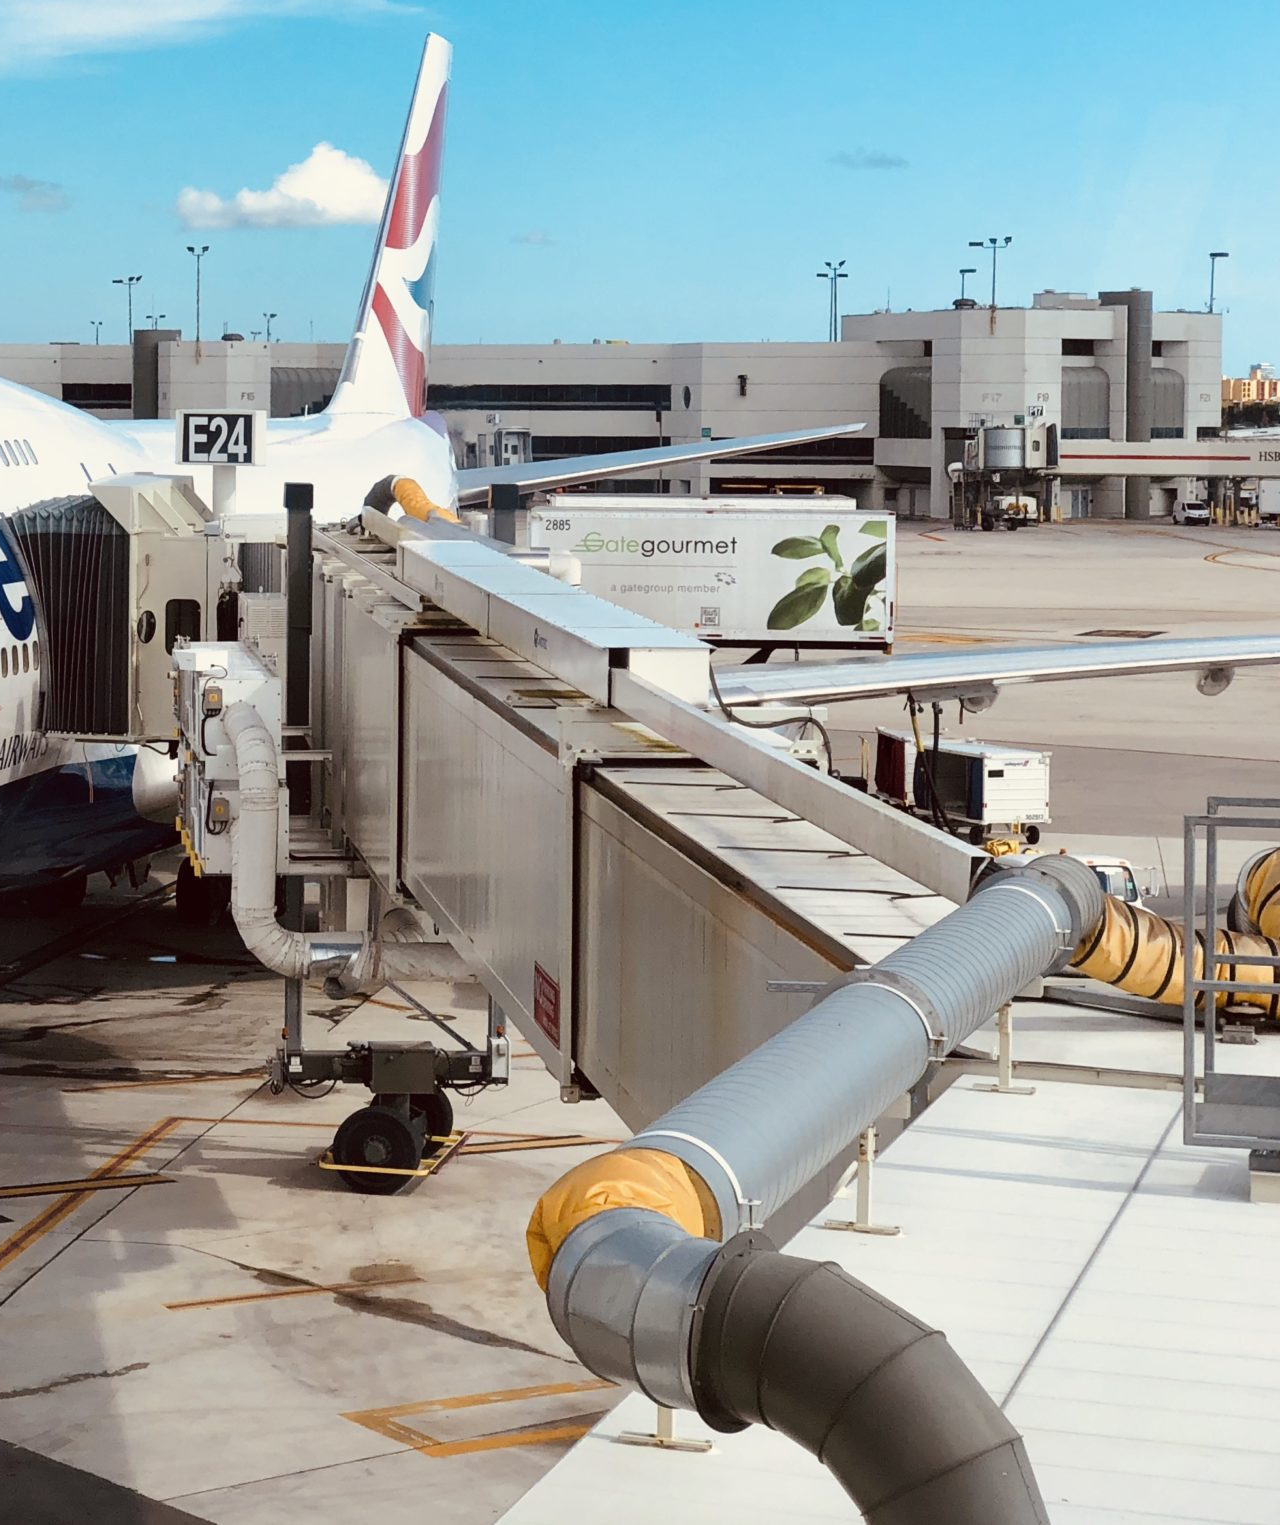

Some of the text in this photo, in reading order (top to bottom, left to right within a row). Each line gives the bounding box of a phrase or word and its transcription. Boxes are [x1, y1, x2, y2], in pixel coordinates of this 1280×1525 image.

[188, 416, 248, 463] E24
[545, 519, 571, 531] 2885
[570, 531, 738, 558] Gategourmet
[610, 583, 721, 595] a gategroup member
